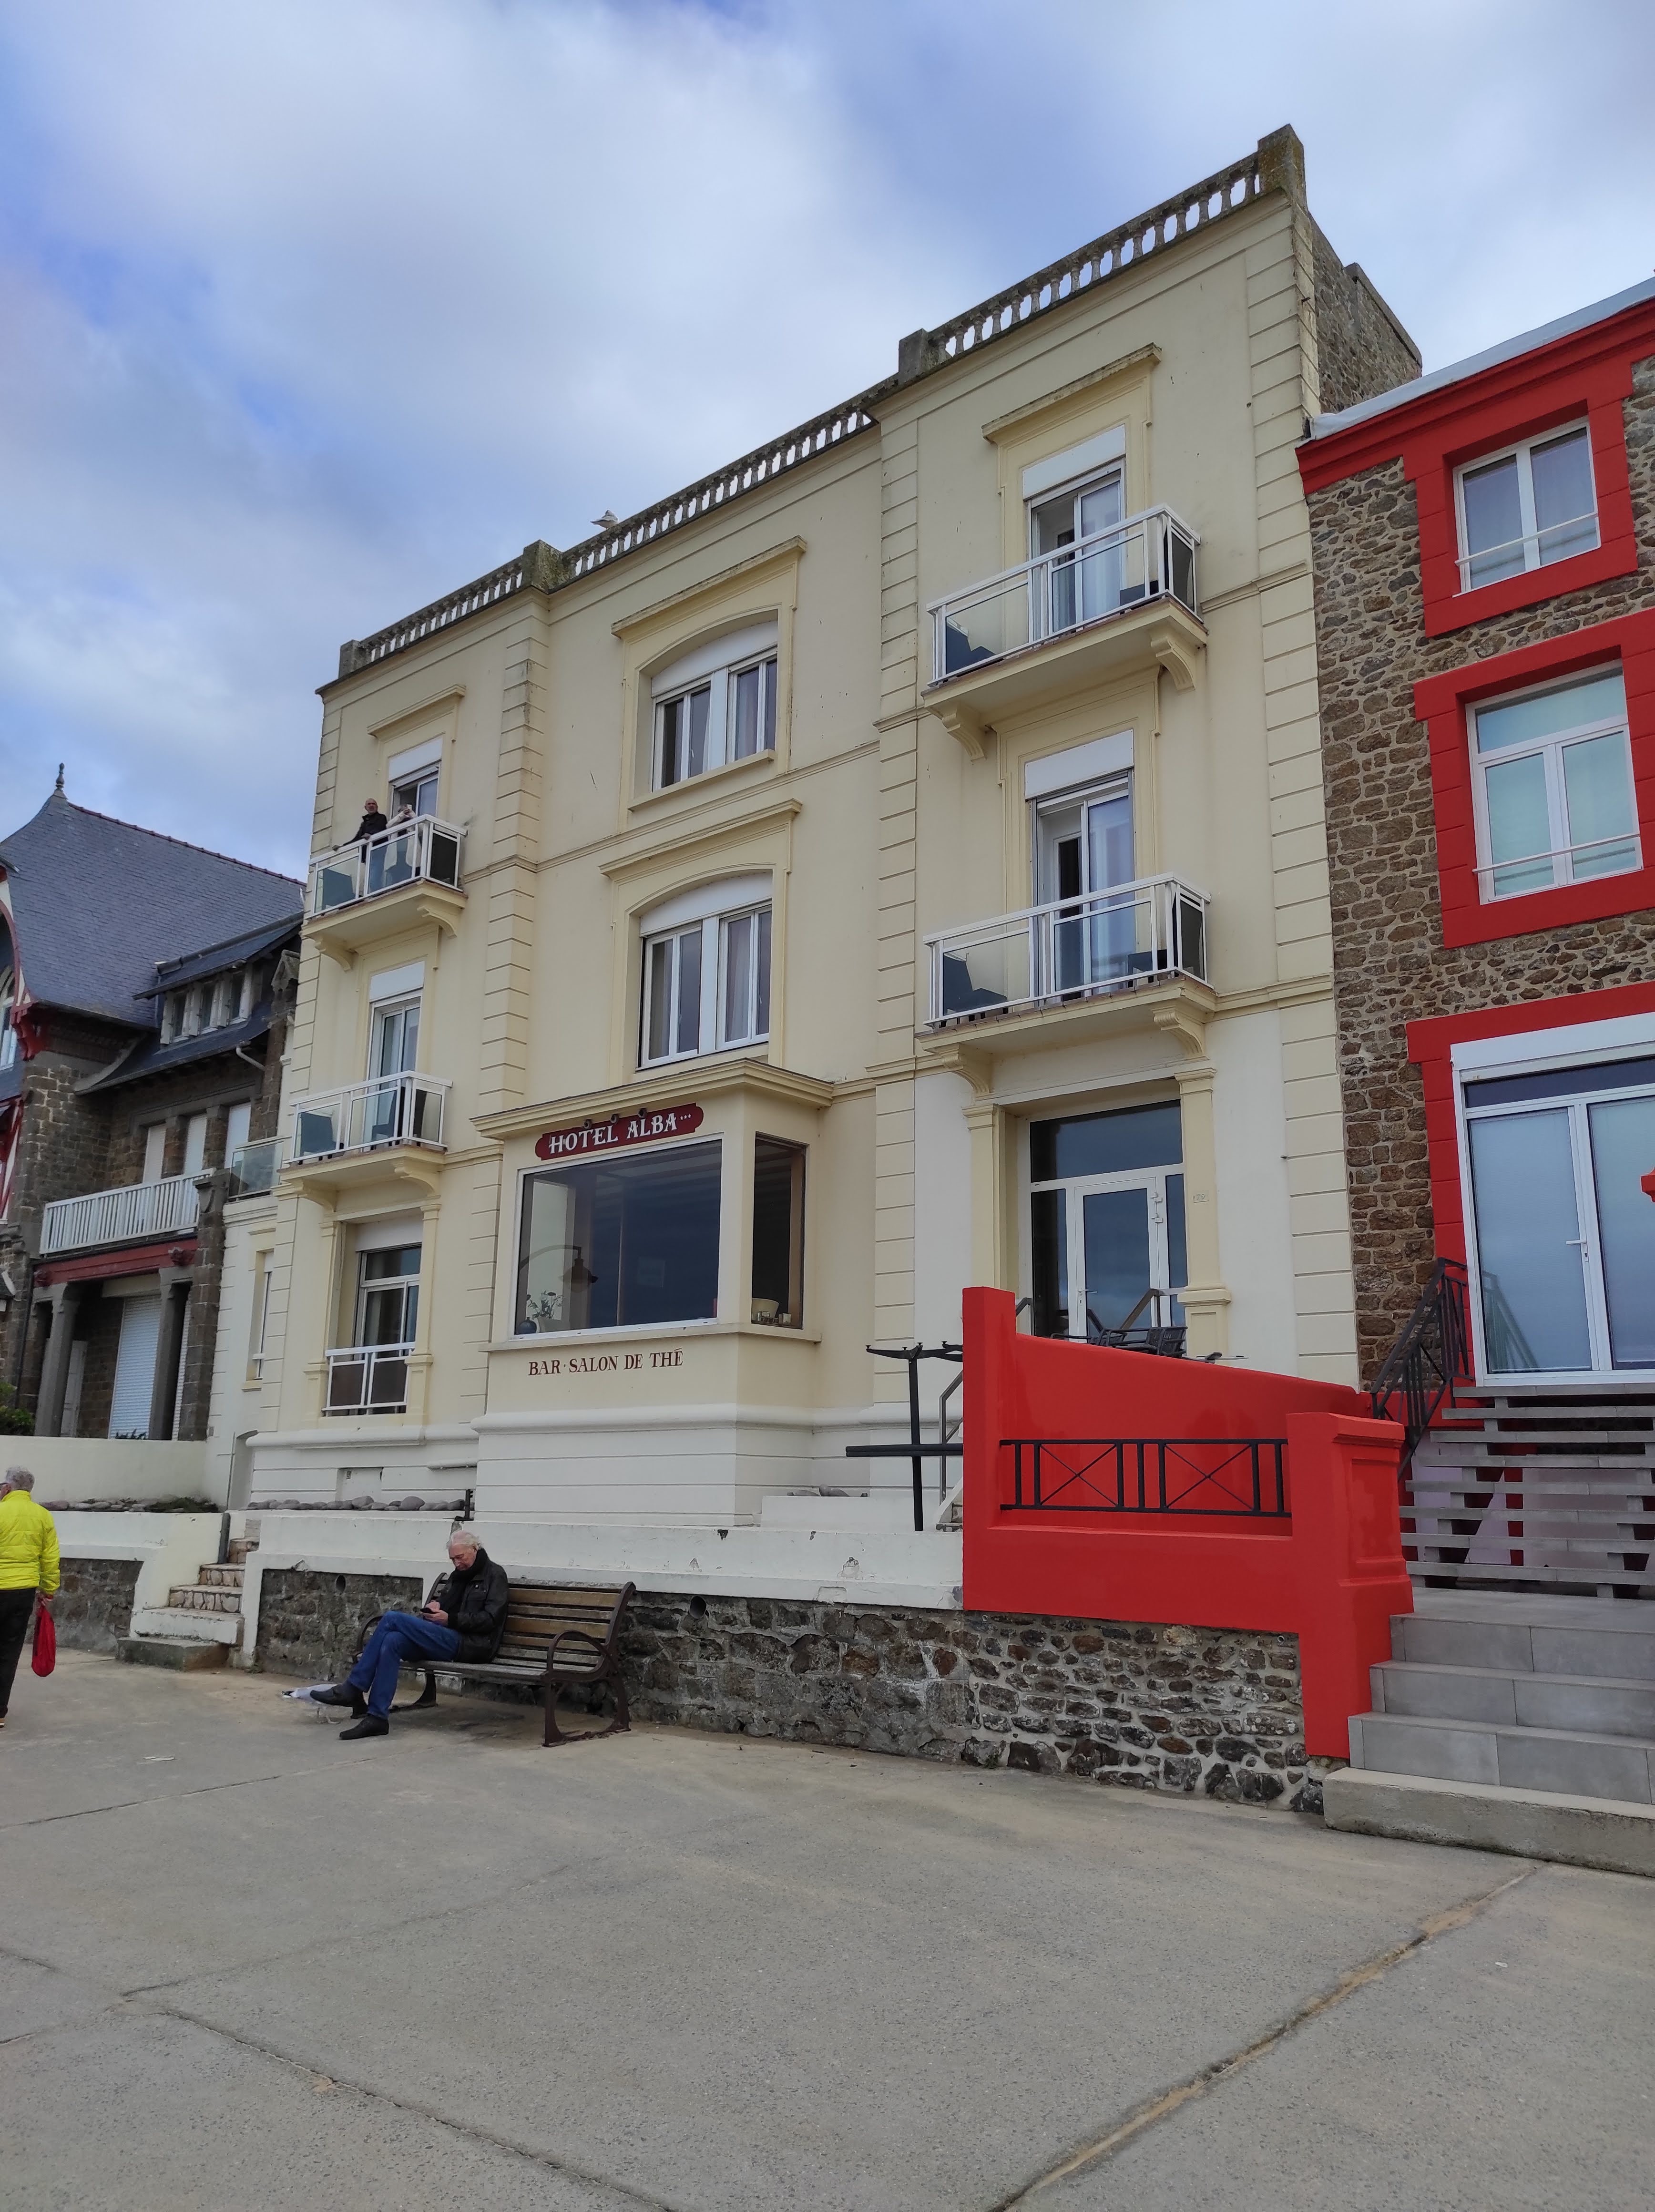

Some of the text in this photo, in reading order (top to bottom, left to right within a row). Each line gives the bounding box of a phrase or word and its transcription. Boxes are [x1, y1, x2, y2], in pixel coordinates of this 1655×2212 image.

[549, 1112, 677, 1154] HOTEL ALBA
[528, 1348, 683, 1375] BAR SALON DE THÉ
